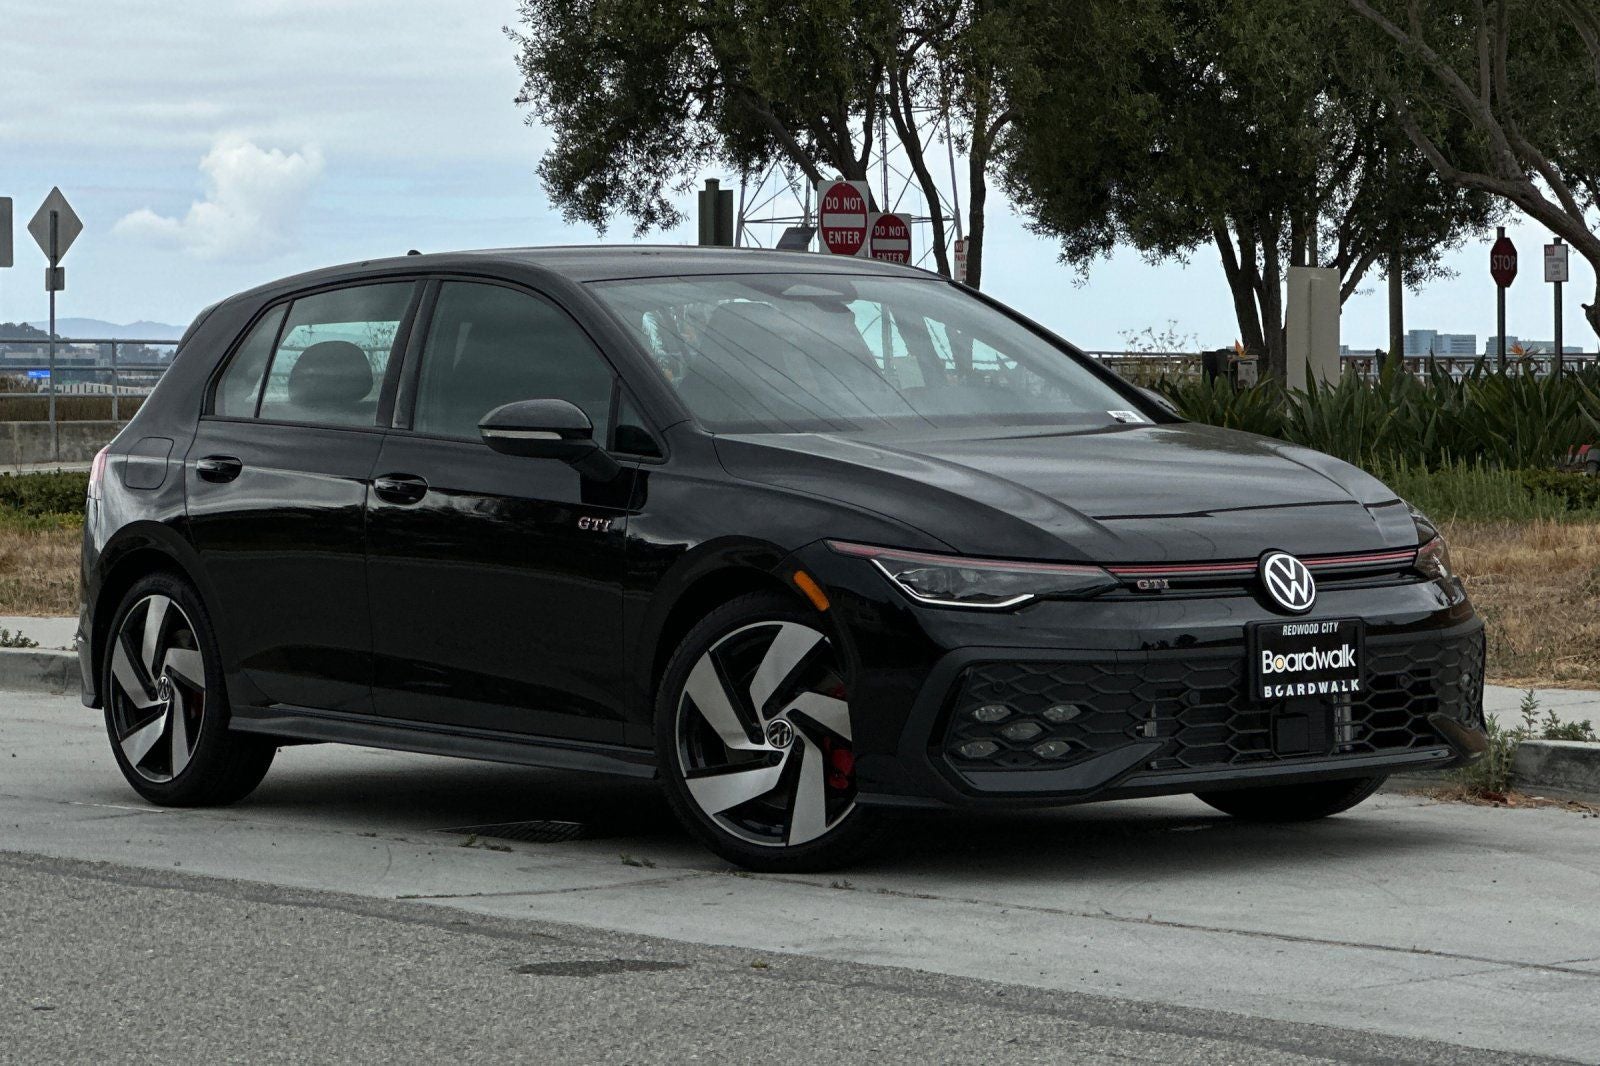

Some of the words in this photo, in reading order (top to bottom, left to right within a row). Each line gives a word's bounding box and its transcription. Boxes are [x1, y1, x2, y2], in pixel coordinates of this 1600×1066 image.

[826, 196, 839, 210] DO
[843, 196, 861, 210] NOT
[828, 230, 860, 244] ENTER
[875, 225, 885, 236] DO
[889, 226, 905, 237] NOT
[1492, 254, 1516, 271] STOP
[578, 516, 611, 532] GTI
[1137, 579, 1170, 590] GTI
[1282, 623, 1319, 636] REDWOOD
[1321, 621, 1339, 634] CITY
[1262, 644, 1356, 674] Boardwalk
[1264, 679, 1360, 698] BOARDWALK
